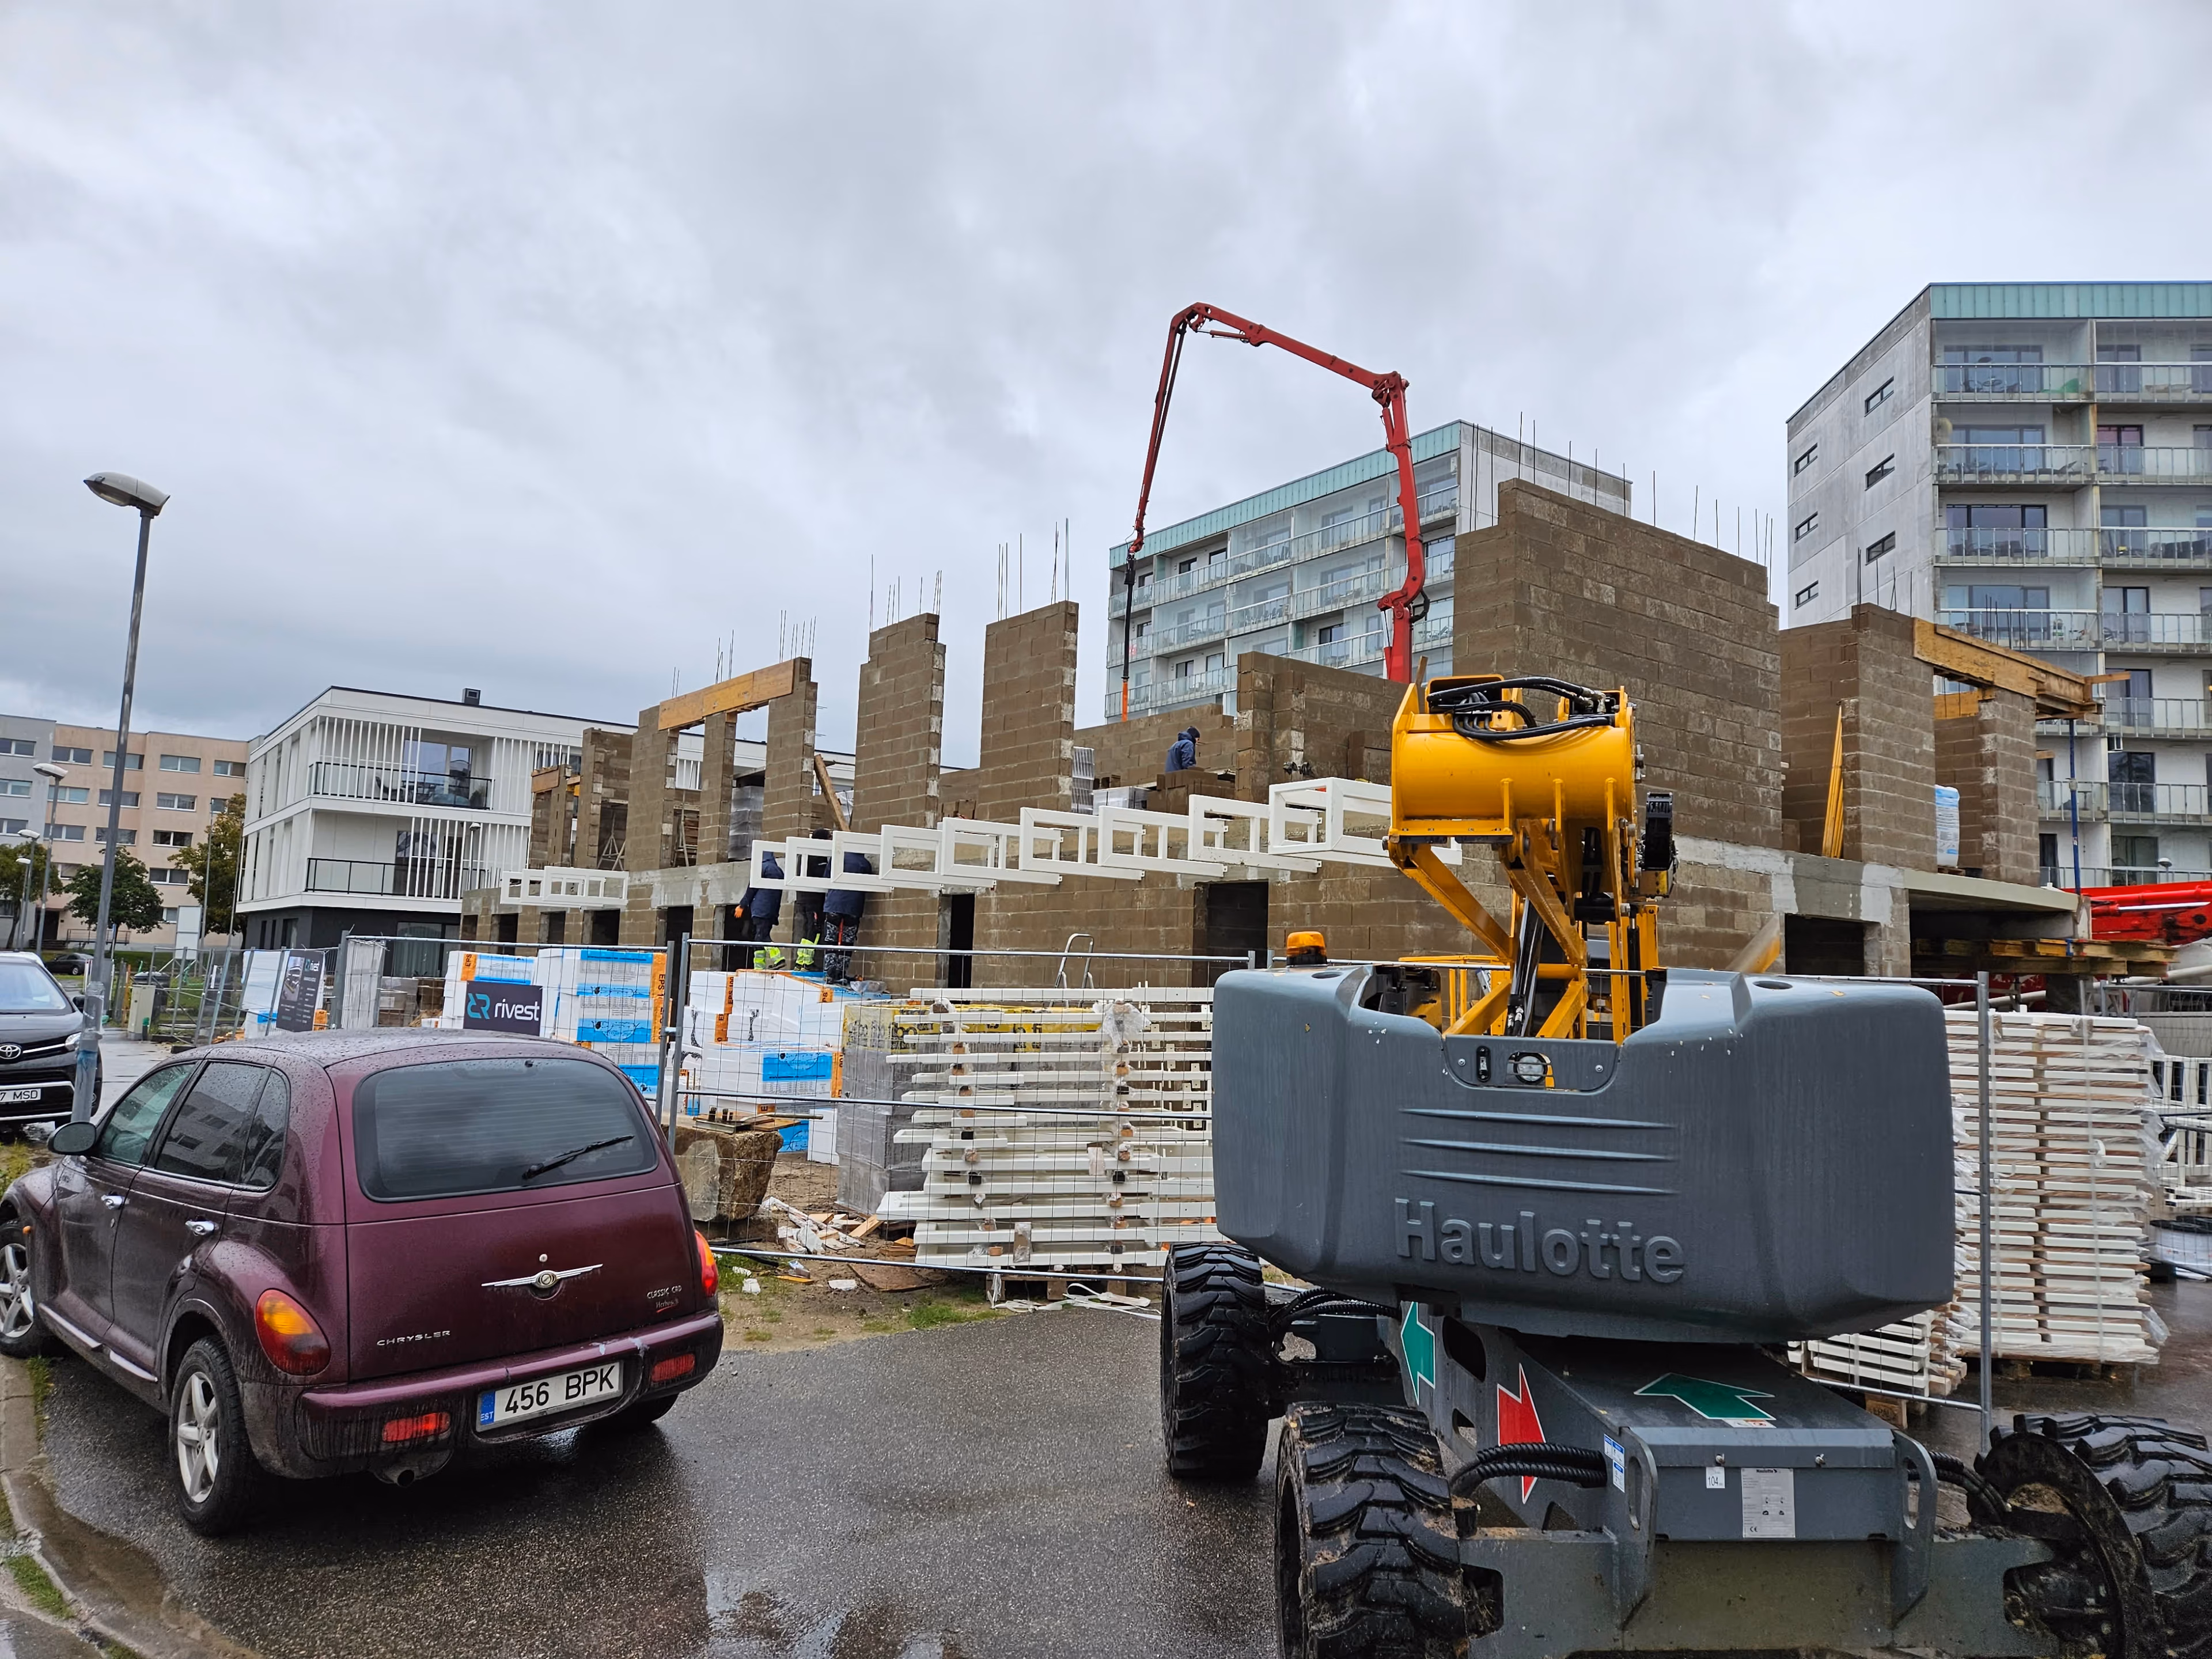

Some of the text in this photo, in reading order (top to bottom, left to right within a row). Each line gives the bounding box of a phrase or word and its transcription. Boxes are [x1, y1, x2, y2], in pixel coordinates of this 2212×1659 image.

[494, 998, 540, 1021] rivest
[13, 1090, 38, 1100] MSD
[1395, 1198, 1684, 1283] Haulotte
[647, 1287, 669, 1298] CLASSIC
[377, 1330, 450, 1346] CHRYSLER
[505, 1365, 615, 1414] 456 BPK
[480, 1411, 494, 1422] EST
[1708, 1476, 1718, 1486] 104
